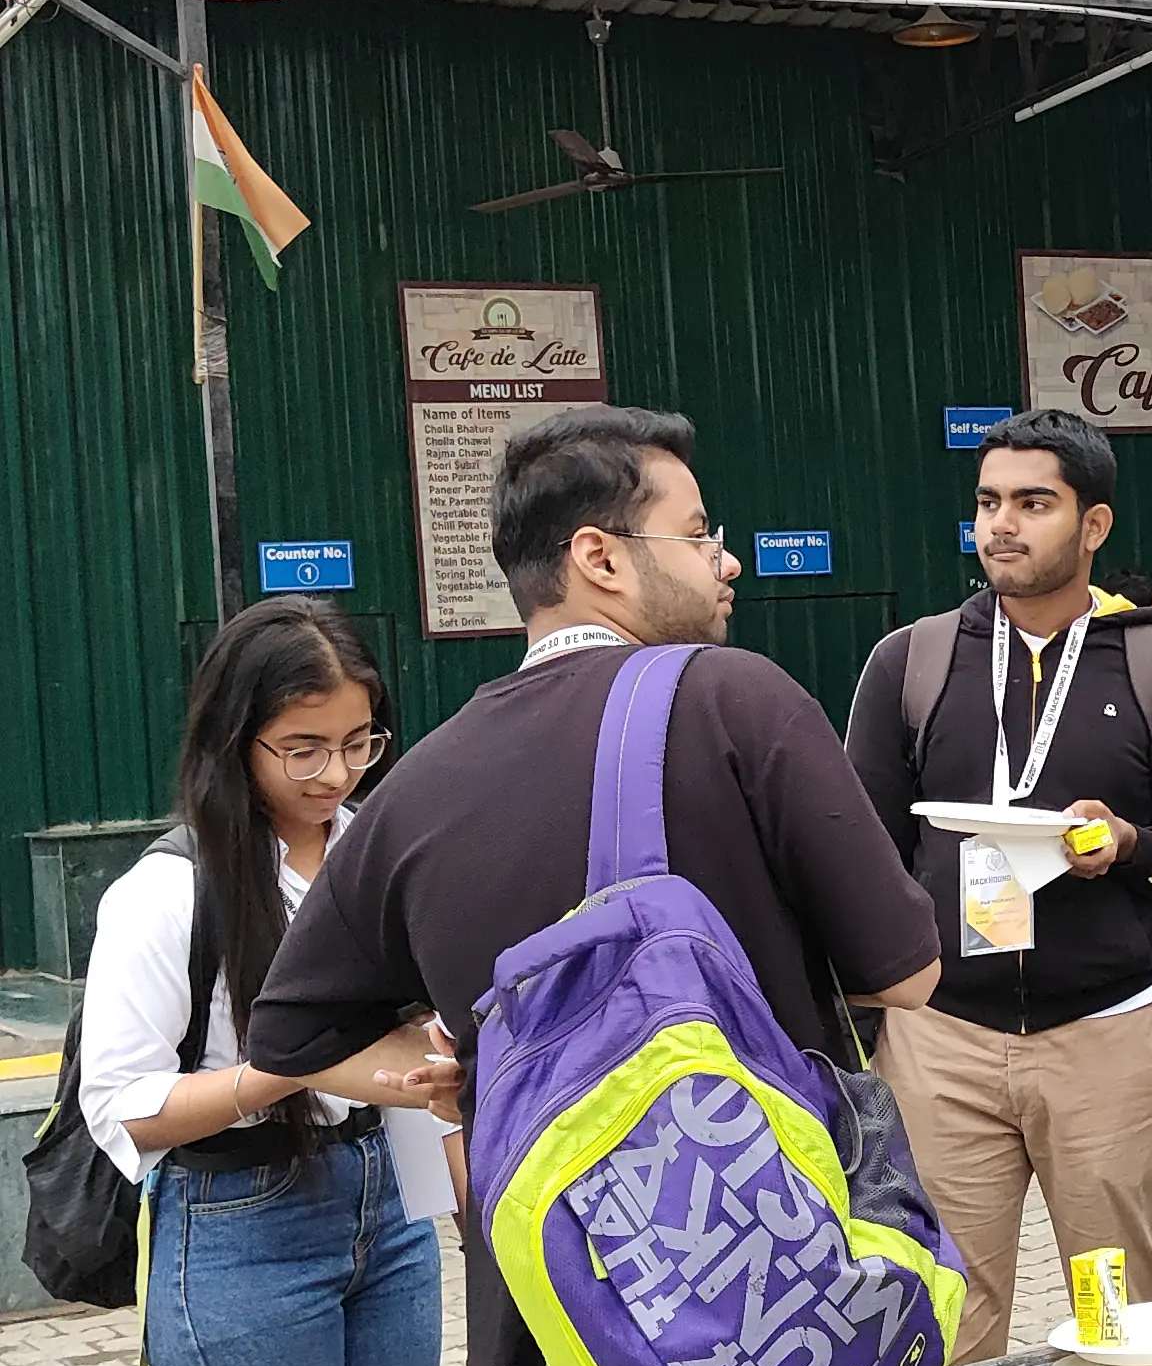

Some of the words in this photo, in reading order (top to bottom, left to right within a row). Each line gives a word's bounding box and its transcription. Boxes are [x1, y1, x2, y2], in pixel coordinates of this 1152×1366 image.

[420, 340, 485, 373] Cafe
[521, 340, 588, 375] Latte
[469, 383, 511, 399] MENU
[514, 383, 544, 399] LIST
[422, 408, 457, 420] Name
[461, 408, 474, 419] of
[477, 408, 511, 419] Items
[424, 424, 454, 434] Cholla
[456, 423, 494, 434] Bhatura
[950, 422, 970, 434] Self
[425, 436, 455, 446] Cholla
[457, 436, 492, 446] Chawal
[426, 449, 456, 459] Rajma
[458, 448, 492, 458] Chawal
[427, 461, 452, 471] Poori
[454, 460, 480, 470] Subzi
[429, 497, 446, 506] Mix
[430, 509, 478, 521] Vegetable
[431, 521, 456, 531] Chilli
[458, 521, 489, 530] Potato
[432, 533, 480, 544] Vegetable
[759, 536, 805, 548] Counter
[806, 535, 826, 547] No.
[266, 547, 321, 561] Counter
[323, 546, 347, 559] No.
[433, 546, 467, 555] Masala
[469, 545, 492, 554] Dosa
[434, 558, 458, 567] Plain
[460, 557, 484, 566] Dosa
[790, 554, 799, 566] 2
[304, 566, 312, 580] 1
[435, 570, 466, 580] Spring
[468, 568, 486, 578] Roll
[436, 581, 484, 592] Vegetable
[437, 594, 474, 604] Samosa
[438, 606, 454, 616] Tea
[438, 618, 458, 628] Soft
[461, 617, 487, 626] Drink
